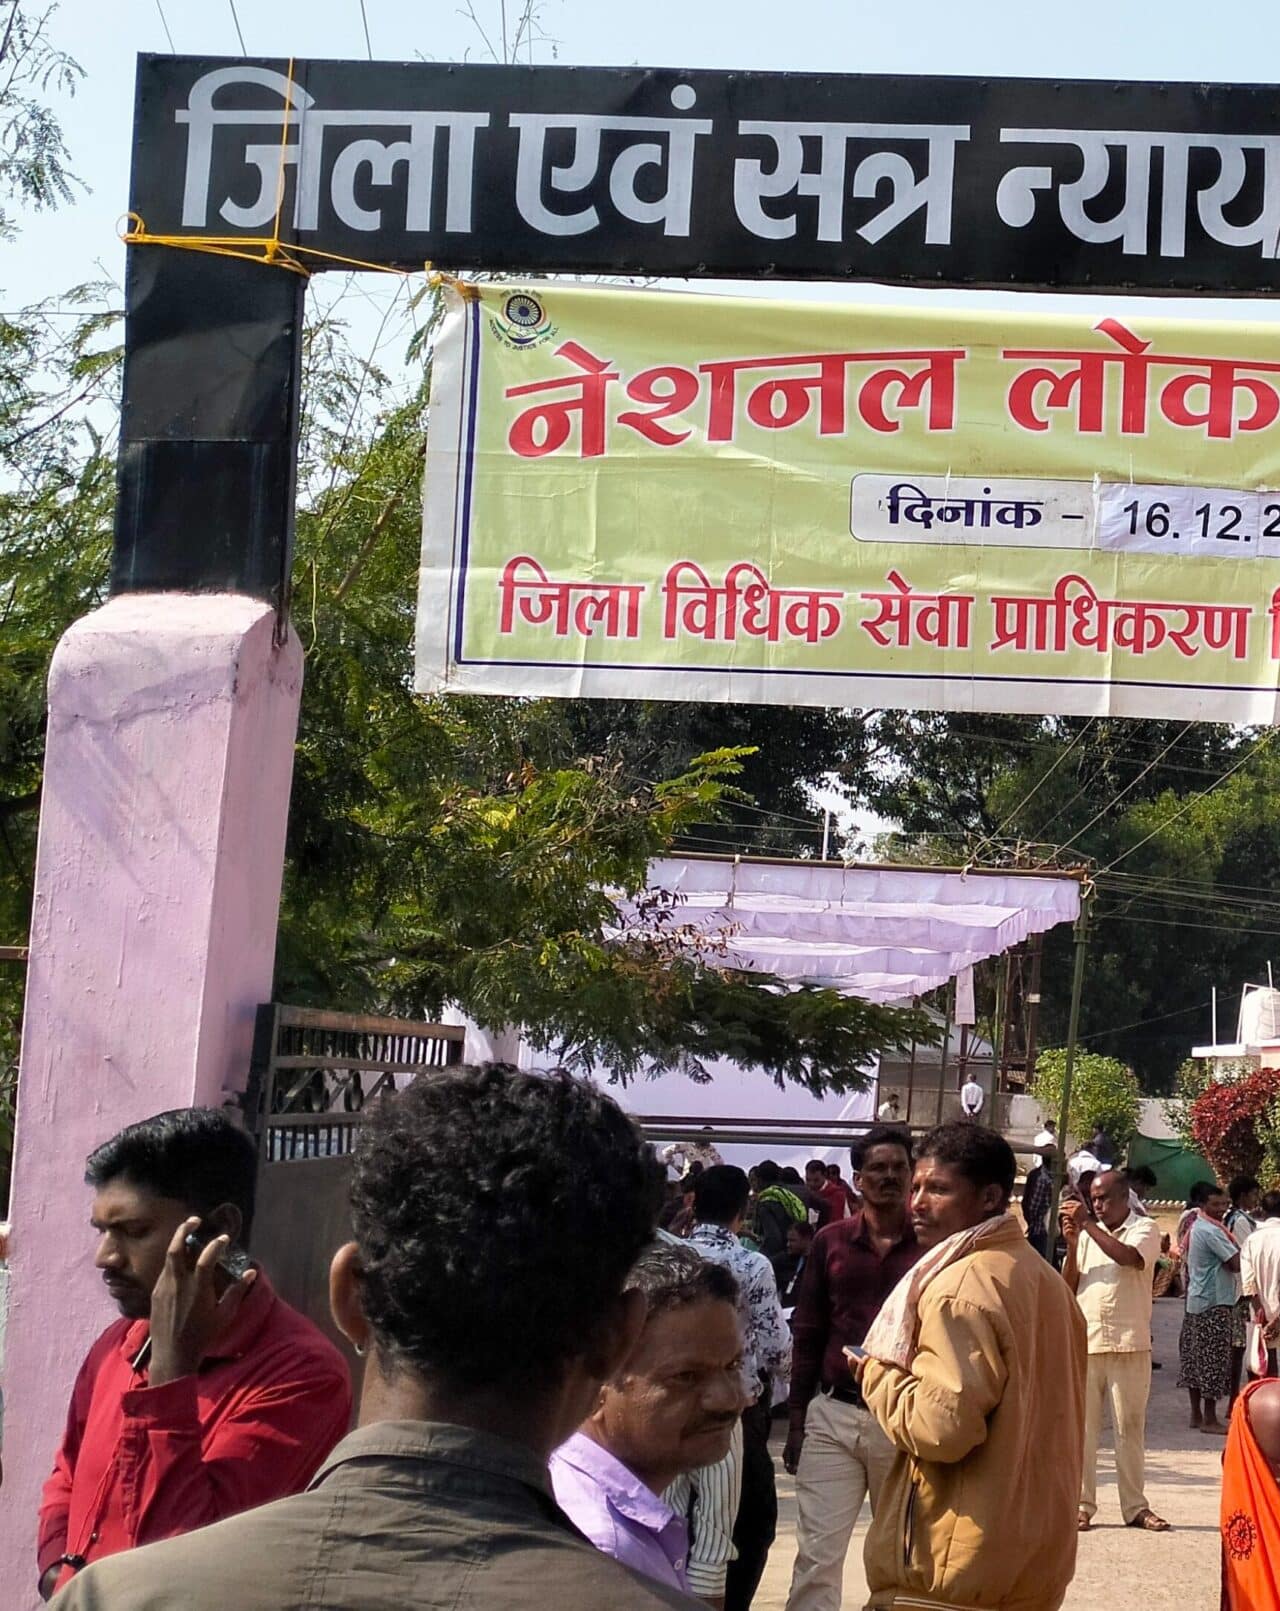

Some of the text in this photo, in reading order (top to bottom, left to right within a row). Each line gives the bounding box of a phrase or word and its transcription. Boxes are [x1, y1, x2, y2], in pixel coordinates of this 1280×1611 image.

[175, 66, 491, 233] जिला
[508, 84, 713, 238] एवं
[733, 120, 971, 246] सत्र
[505, 340, 967, 459] नेशनल
[886, 483, 1046, 530] दिनांक
[498, 556, 646, 639] जिला
[662, 561, 844, 643] विधिक
[860, 569, 975, 649] सेवा
[991, 574, 1252, 660] प्राधिकरण
